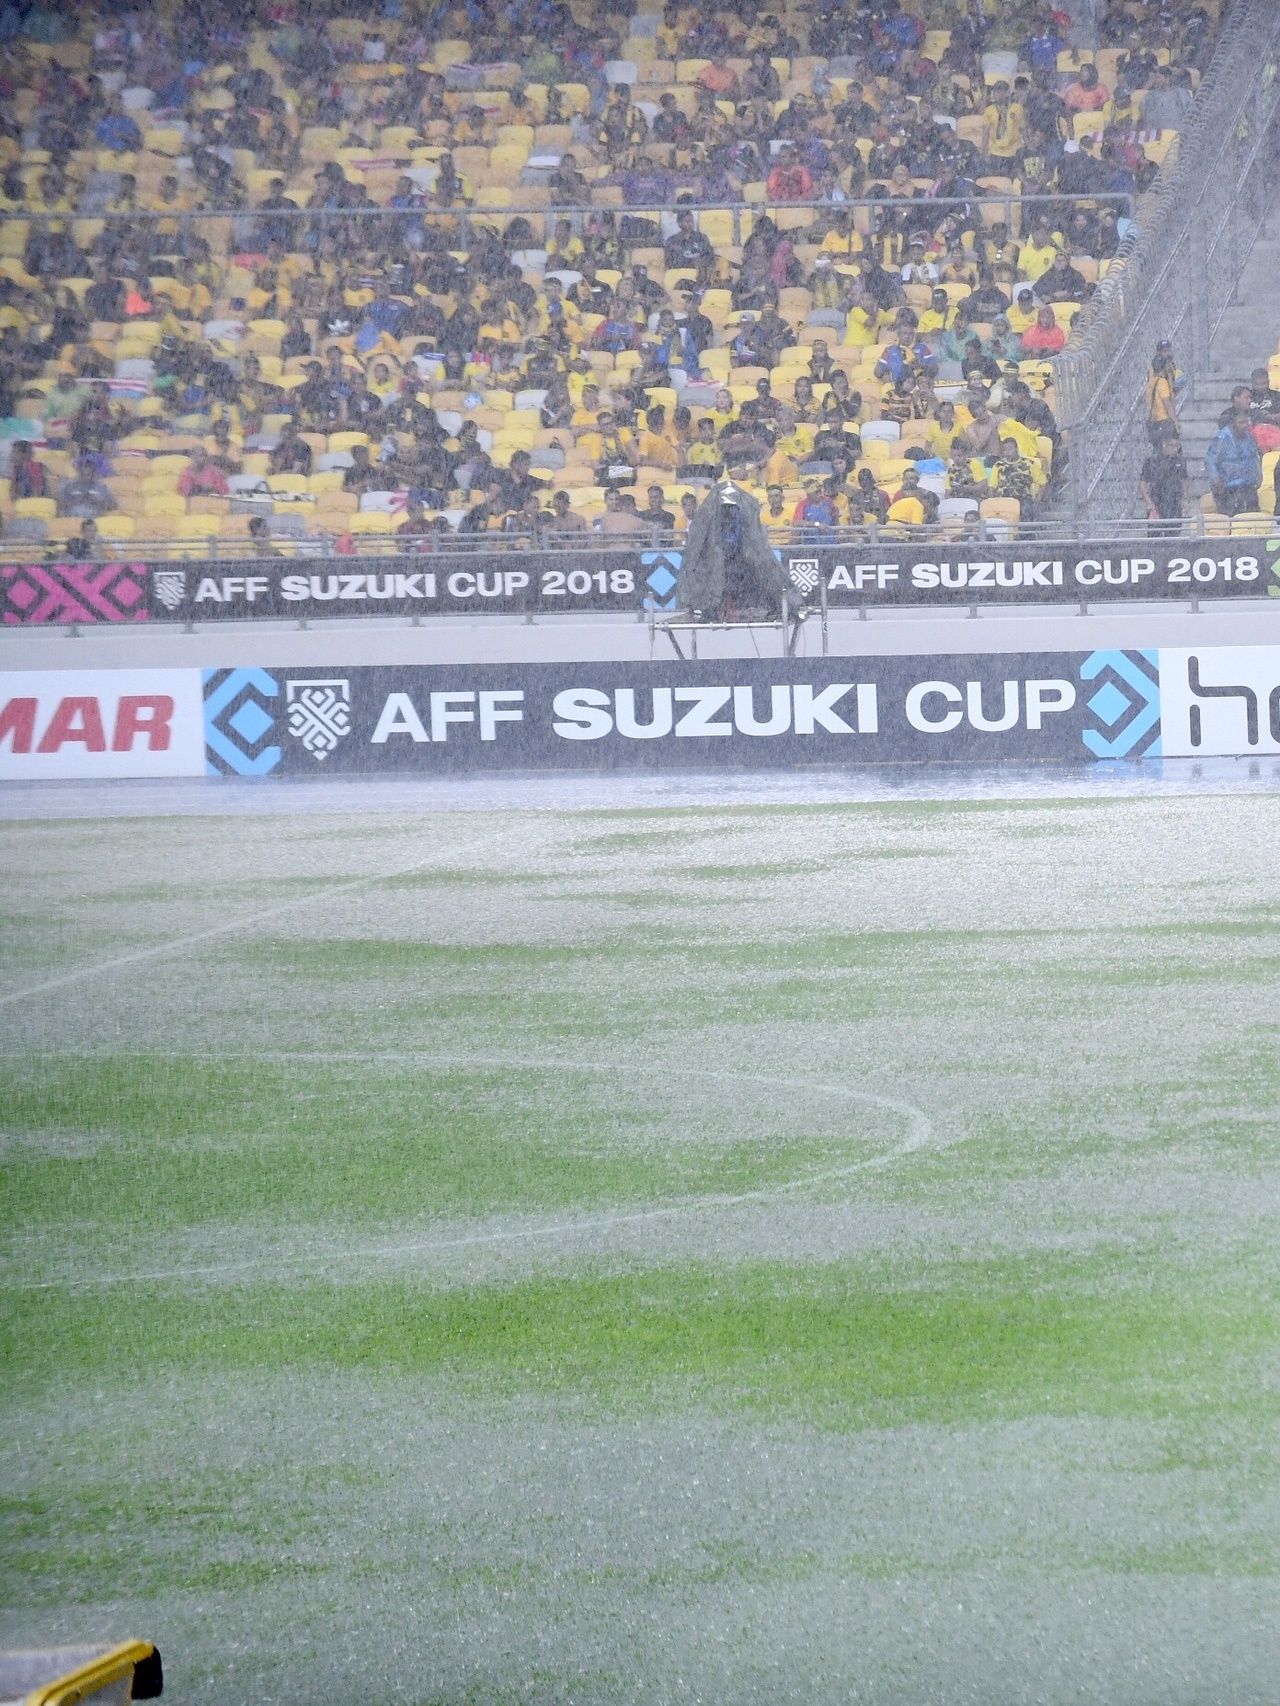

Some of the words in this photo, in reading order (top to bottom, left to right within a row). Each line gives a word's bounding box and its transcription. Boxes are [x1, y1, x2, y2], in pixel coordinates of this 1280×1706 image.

[194, 577, 269, 602] AFF
[280, 573, 437, 601] SUZUKI
[446, 571, 530, 597] CUP
[541, 569, 635, 596] 2018
[827, 564, 900, 590] AFF
[911, 560, 1064, 589] SUZUKI
[1074, 558, 1156, 586] CUP
[1167, 556, 1260, 583] 2018
[370, 690, 525, 744] AFF
[552, 683, 879, 741] SUZUKI
[905, 679, 1077, 734] CUP
